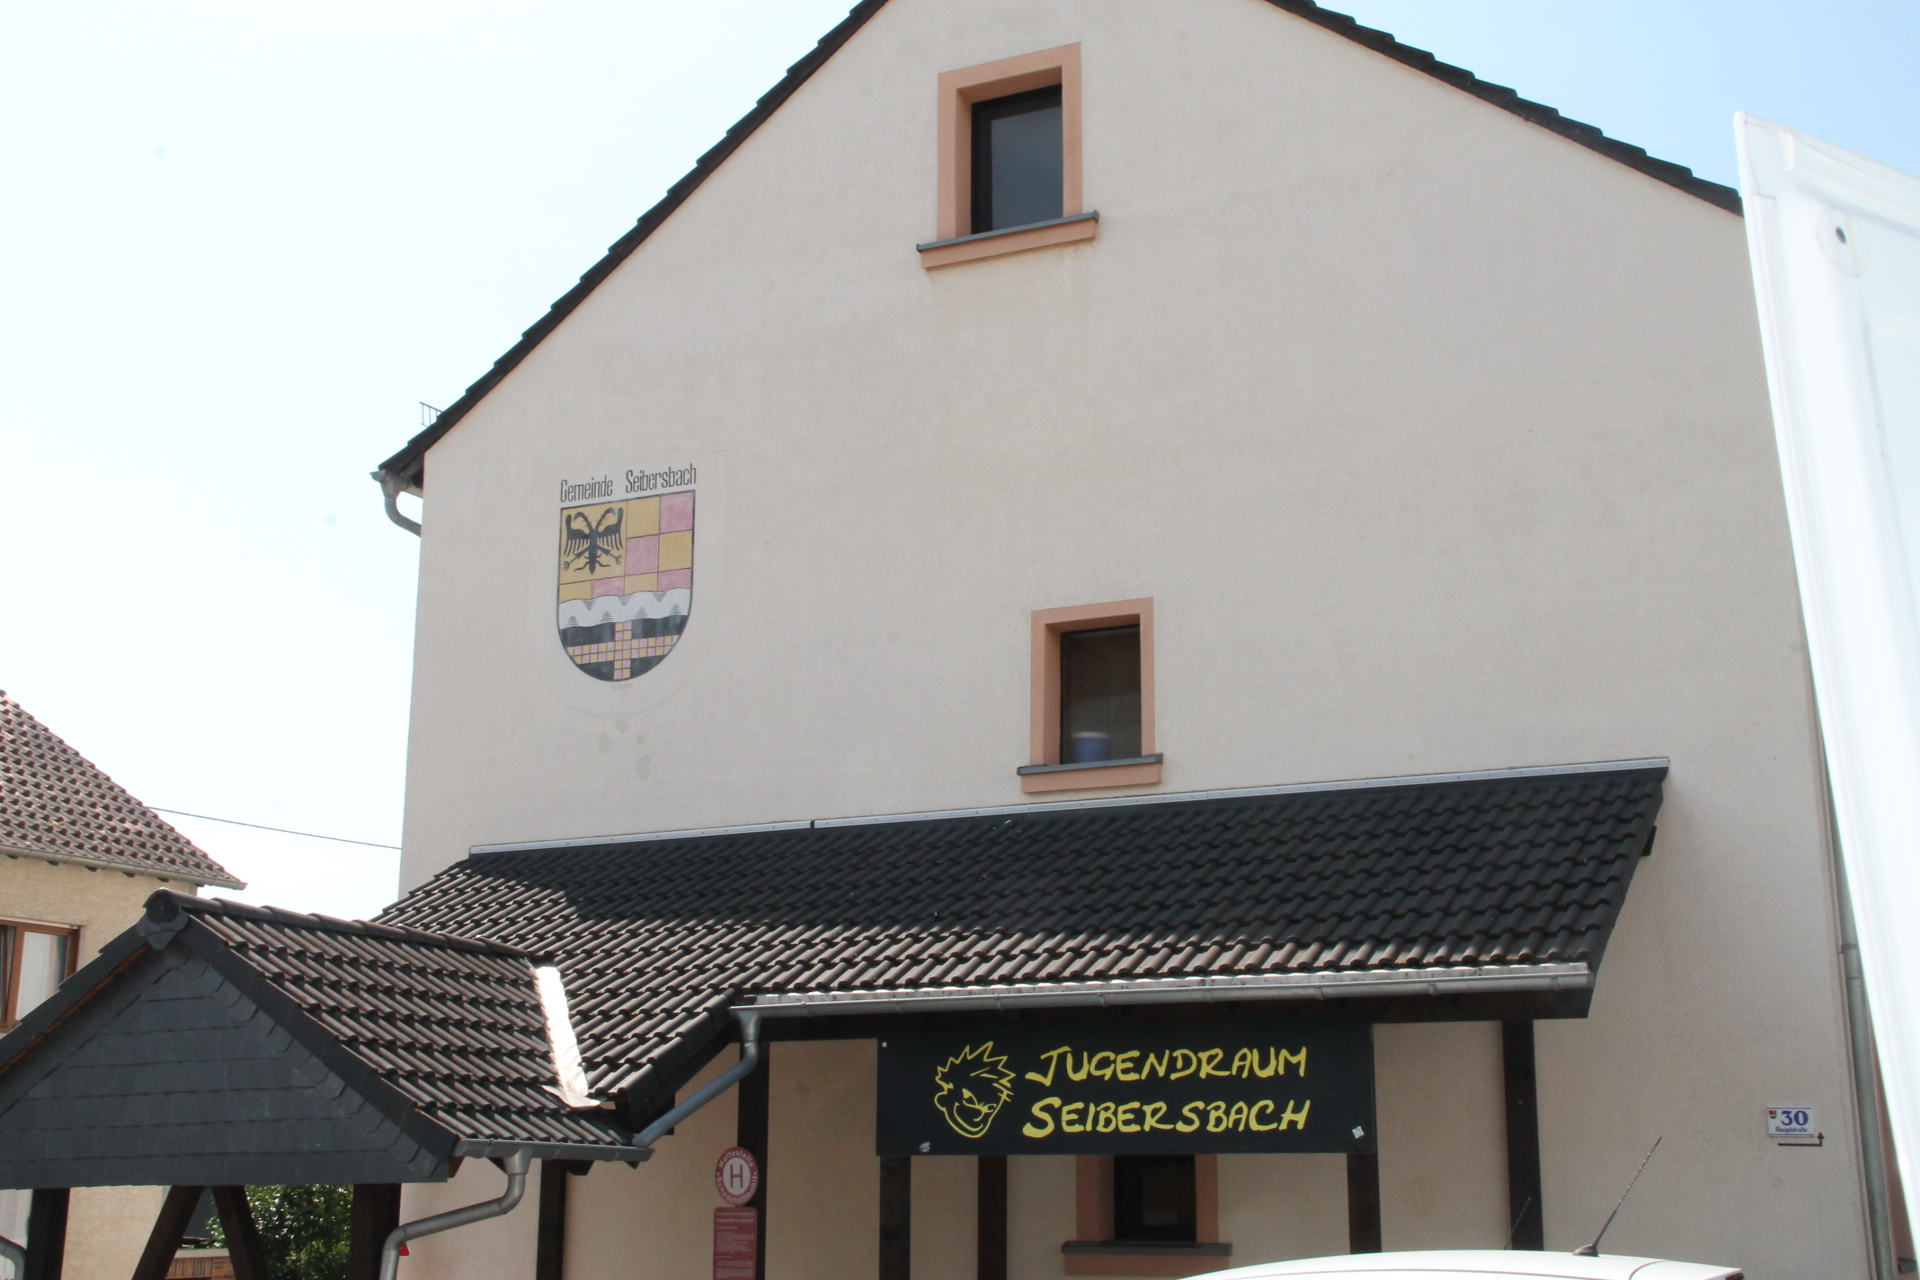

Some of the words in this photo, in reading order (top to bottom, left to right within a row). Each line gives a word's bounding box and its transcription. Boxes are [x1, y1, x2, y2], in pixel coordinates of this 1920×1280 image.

[560, 475, 613, 502] Gemeinde
[625, 463, 697, 493] Seibersbach
[1024, 1046, 1307, 1086] JUGENDRAUM
[1022, 1096, 1311, 1138] SEIBERSBACH
[1780, 1110, 1809, 1126] 30
[718, 1150, 754, 1168] Haltestelle
[729, 1163, 744, 1189] H
